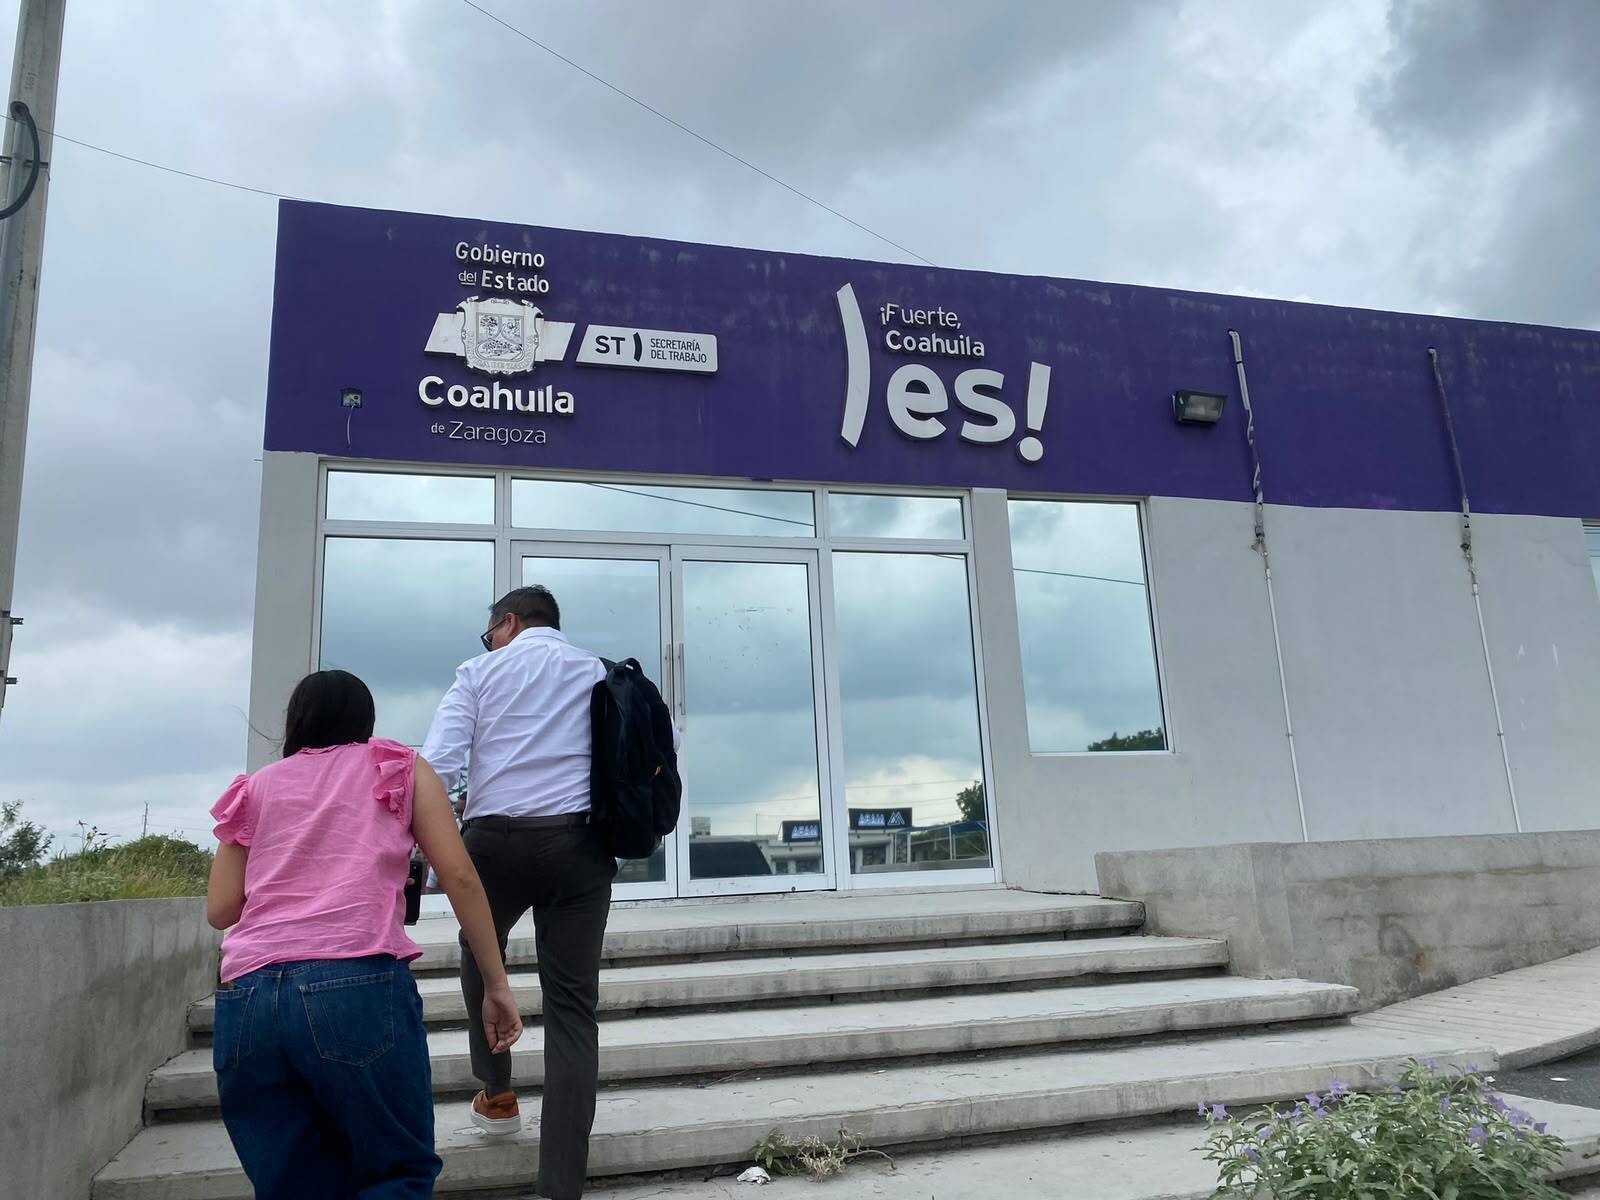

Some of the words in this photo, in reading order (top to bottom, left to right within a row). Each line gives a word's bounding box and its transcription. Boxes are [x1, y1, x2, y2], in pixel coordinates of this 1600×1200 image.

[456, 241, 545, 268] Gobierno
[458, 270, 477, 285] del
[481, 270, 549, 293] Estado
[650, 338, 701, 351] SECRETARÍA
[885, 330, 985, 356] Coahuila
[650, 350, 667, 360] DEL
[669, 351, 707, 363] TRABAJO
[418, 376, 574, 413] Coahuila
[431, 423, 444, 433] de
[449, 421, 547, 445] Zaragoza
